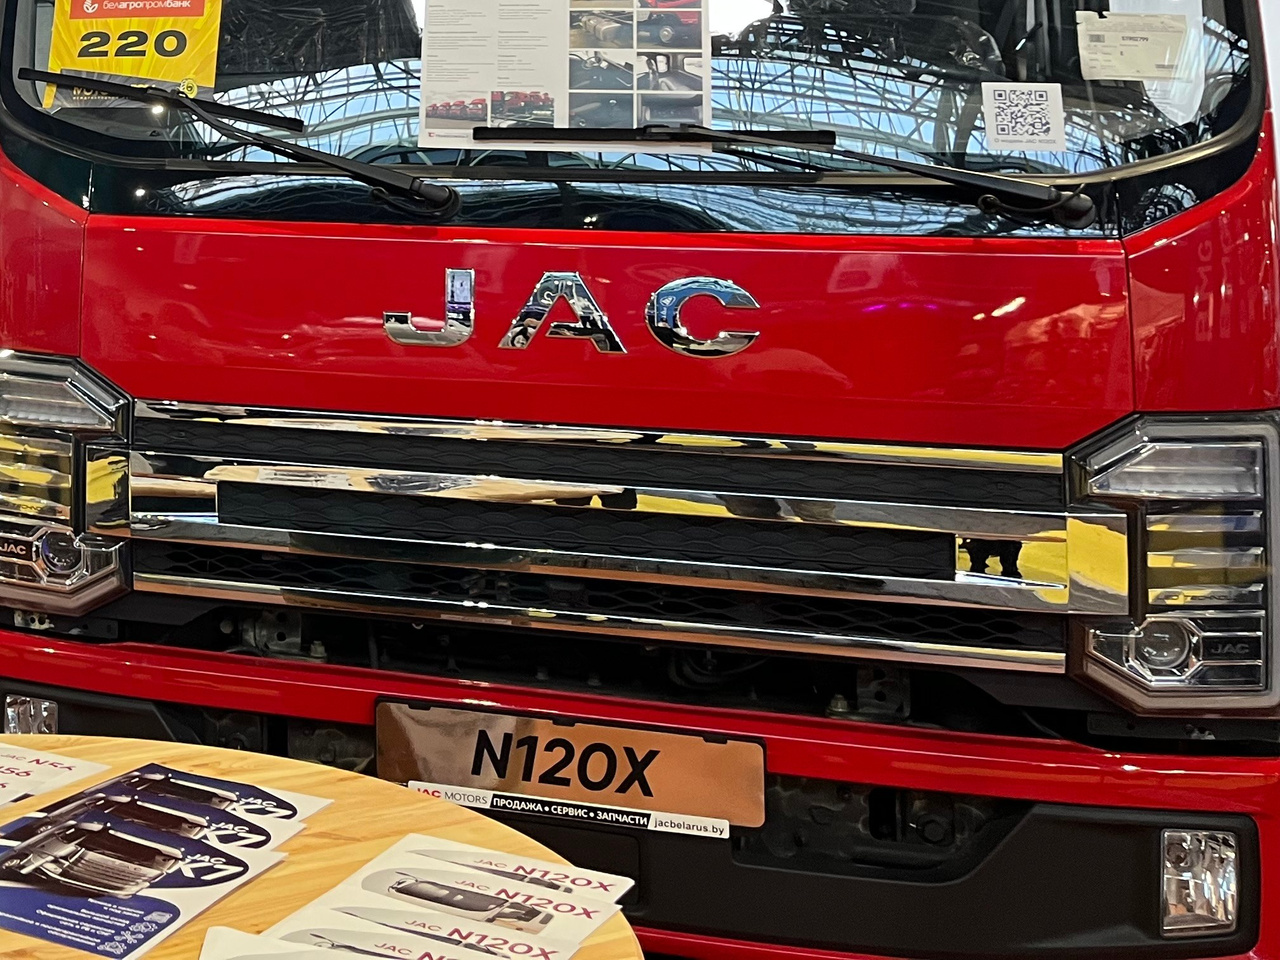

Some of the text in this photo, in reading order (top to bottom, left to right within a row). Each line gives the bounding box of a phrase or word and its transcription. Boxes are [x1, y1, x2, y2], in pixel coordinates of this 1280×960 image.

[77, 29, 188, 58] 220
[382, 267, 761, 358] JAC
[0, 542, 26, 555] JAC
[1211, 643, 1249, 654] JAC
[471, 729, 661, 798] N120X
[240, 797, 277, 807] JAC
[417, 787, 488, 804] AC MOTORS
[493, 797, 648, 826] ПРОДАЖА СЕРВИС ЗАПЧАСТИ
[211, 822, 249, 833] JAC
[654, 818, 725, 836] jacbelarus.by
[185, 853, 226, 865] JAC
[166, 860, 245, 880] K7
[473, 859, 616, 892] JAC N120X
[454, 880, 601, 920] JAC N120X
[374, 943, 413, 956] JAC
[404, 920, 560, 960] JAC N120X
